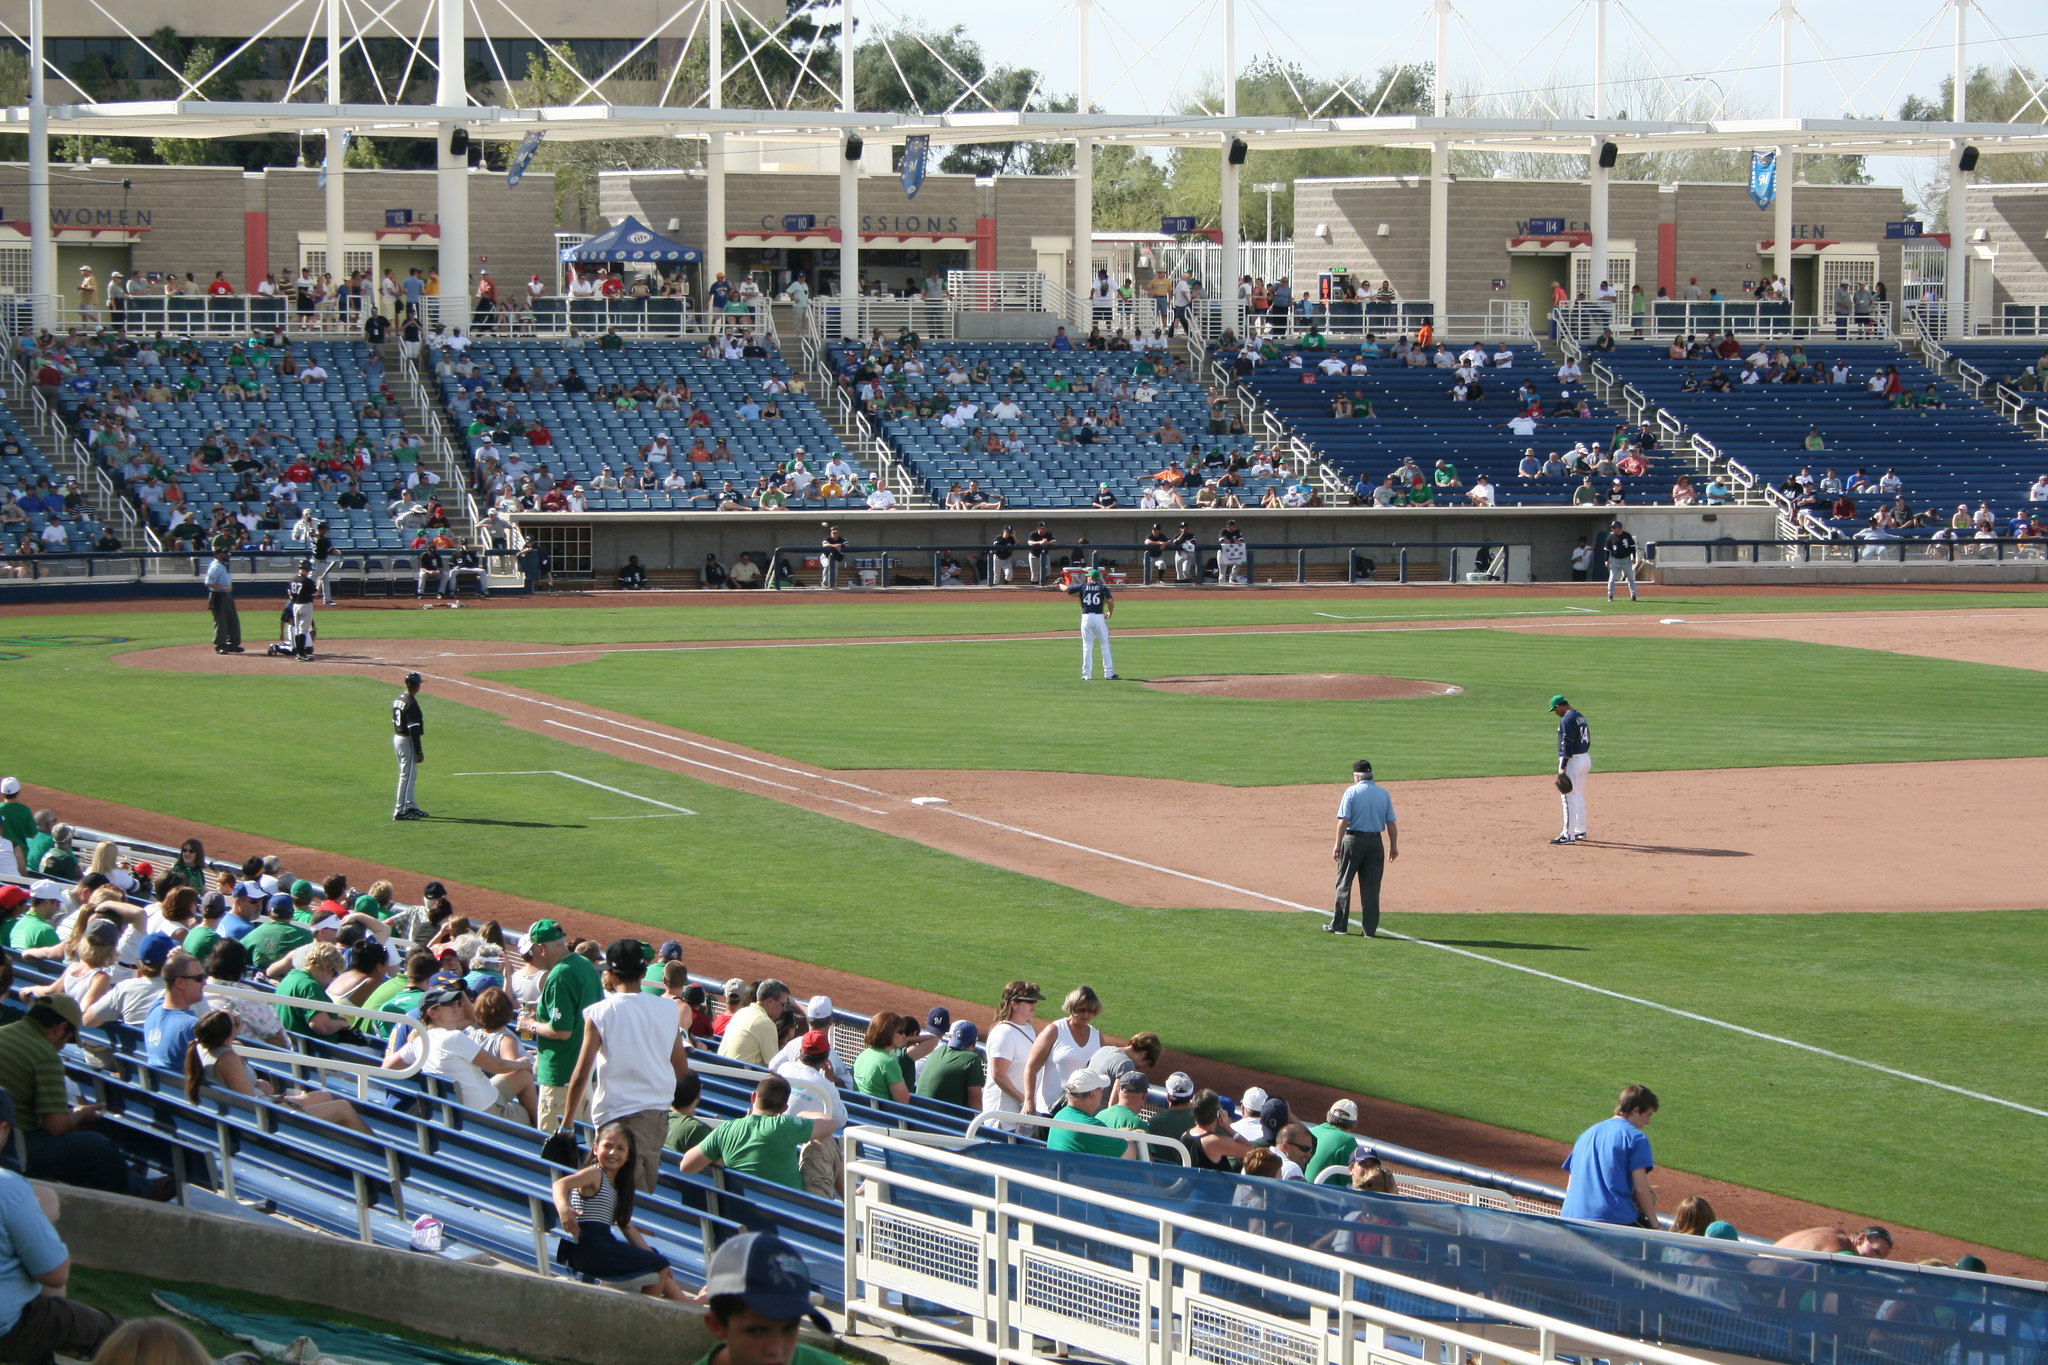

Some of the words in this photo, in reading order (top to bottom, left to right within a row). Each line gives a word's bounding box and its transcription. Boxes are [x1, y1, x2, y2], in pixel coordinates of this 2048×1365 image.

[50, 208, 152, 226] WOMEN
[760, 214, 958, 232] CCSSIONS
[798, 217, 807, 229] 110
[1177, 219, 1188, 231] 112
[1546, 221, 1557, 233] 114
[1904, 223, 1916, 237] 116
[291, 582, 303, 595] 87
[1083, 592, 1101, 606] 46
